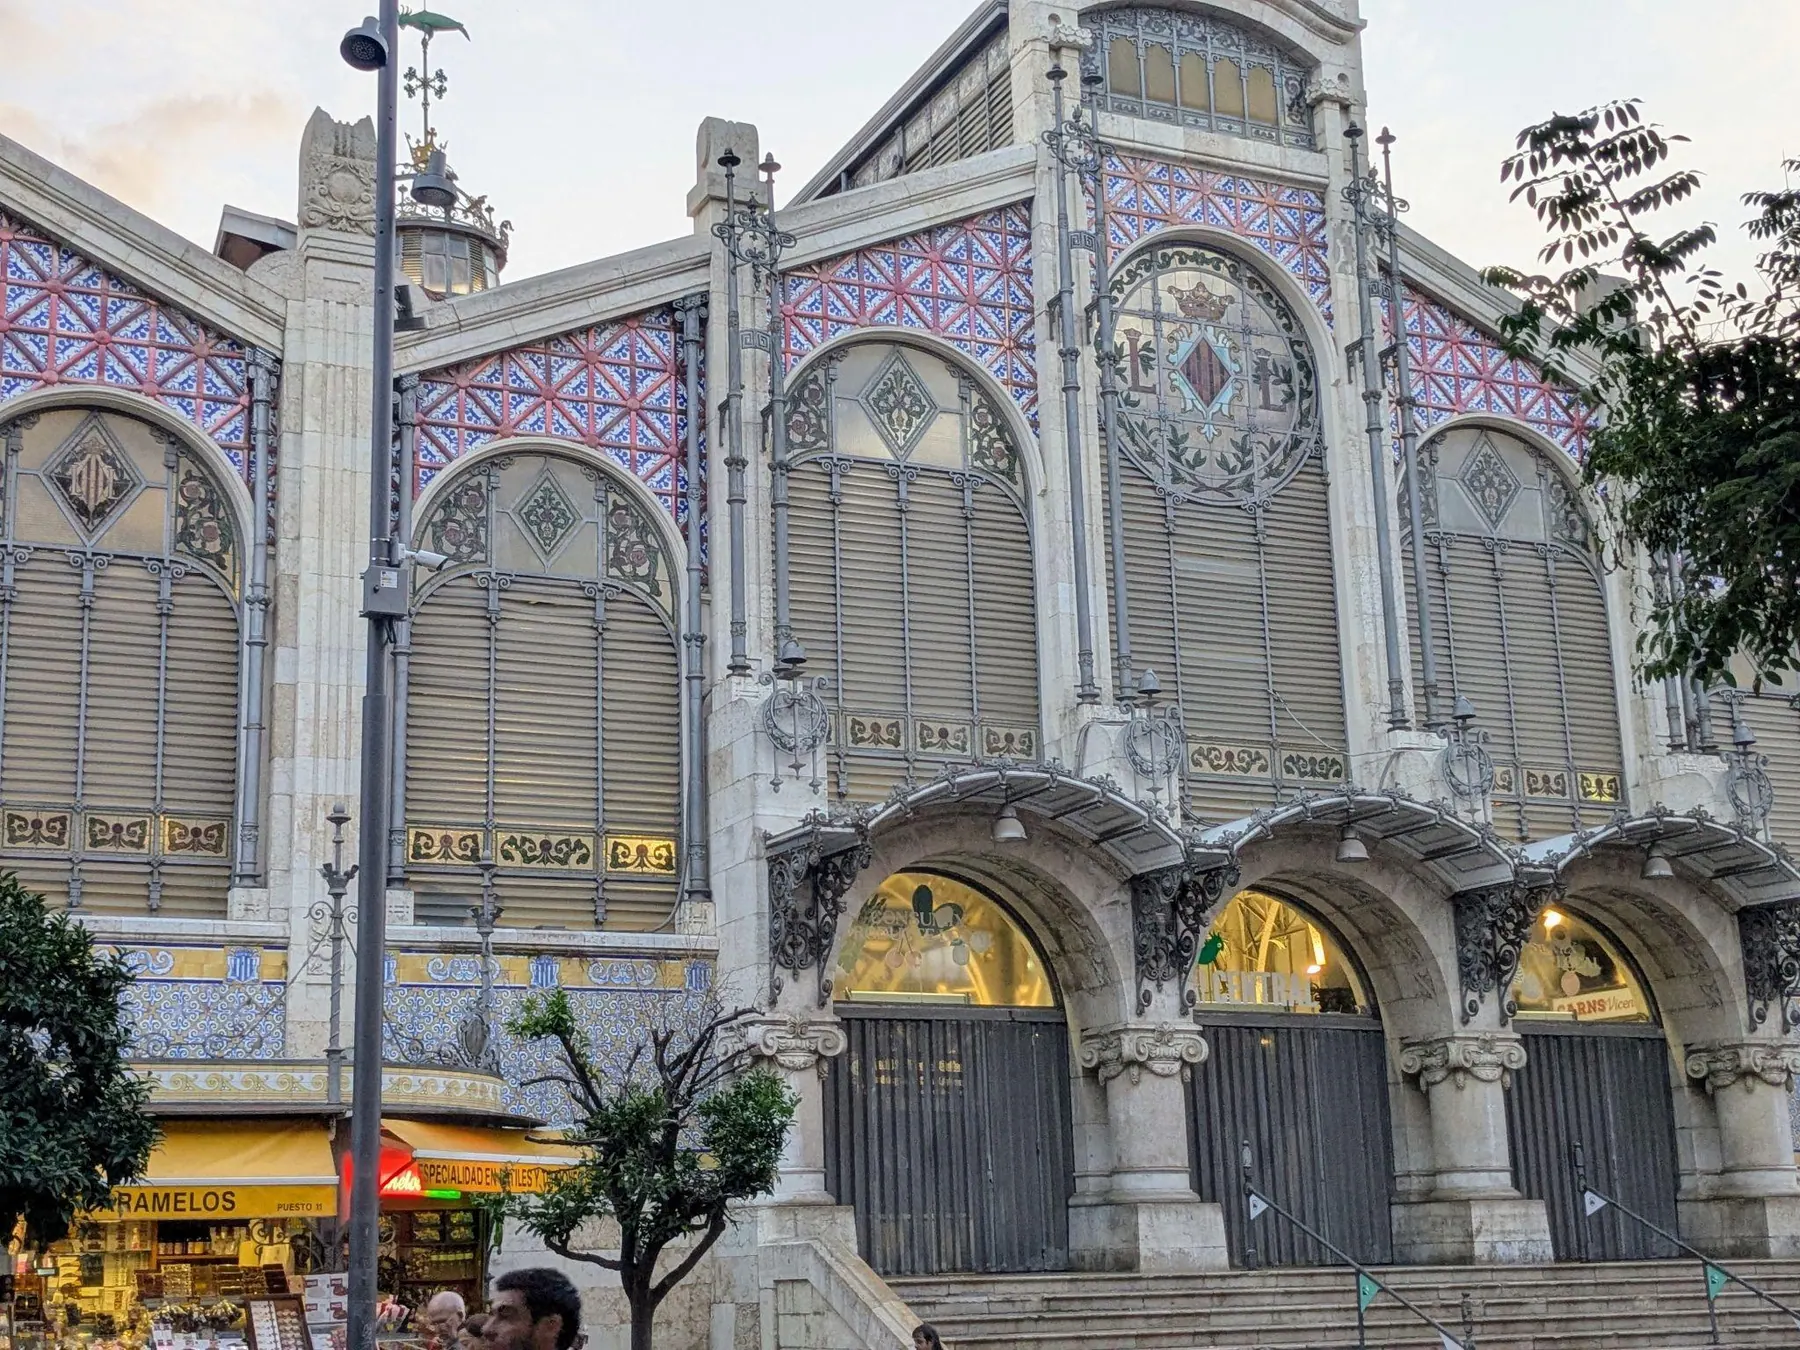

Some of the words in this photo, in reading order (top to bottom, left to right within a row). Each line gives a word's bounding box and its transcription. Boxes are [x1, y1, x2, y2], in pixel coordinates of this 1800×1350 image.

[1213, 969, 1321, 1007] CENTRAL
[484, 1167, 497, 1187] EN
[533, 1168, 540, 1188] Y
[84, 1190, 236, 1213] RAMELOS
[276, 1202, 312, 1213] PUESTO
[315, 1203, 323, 1211] 11
